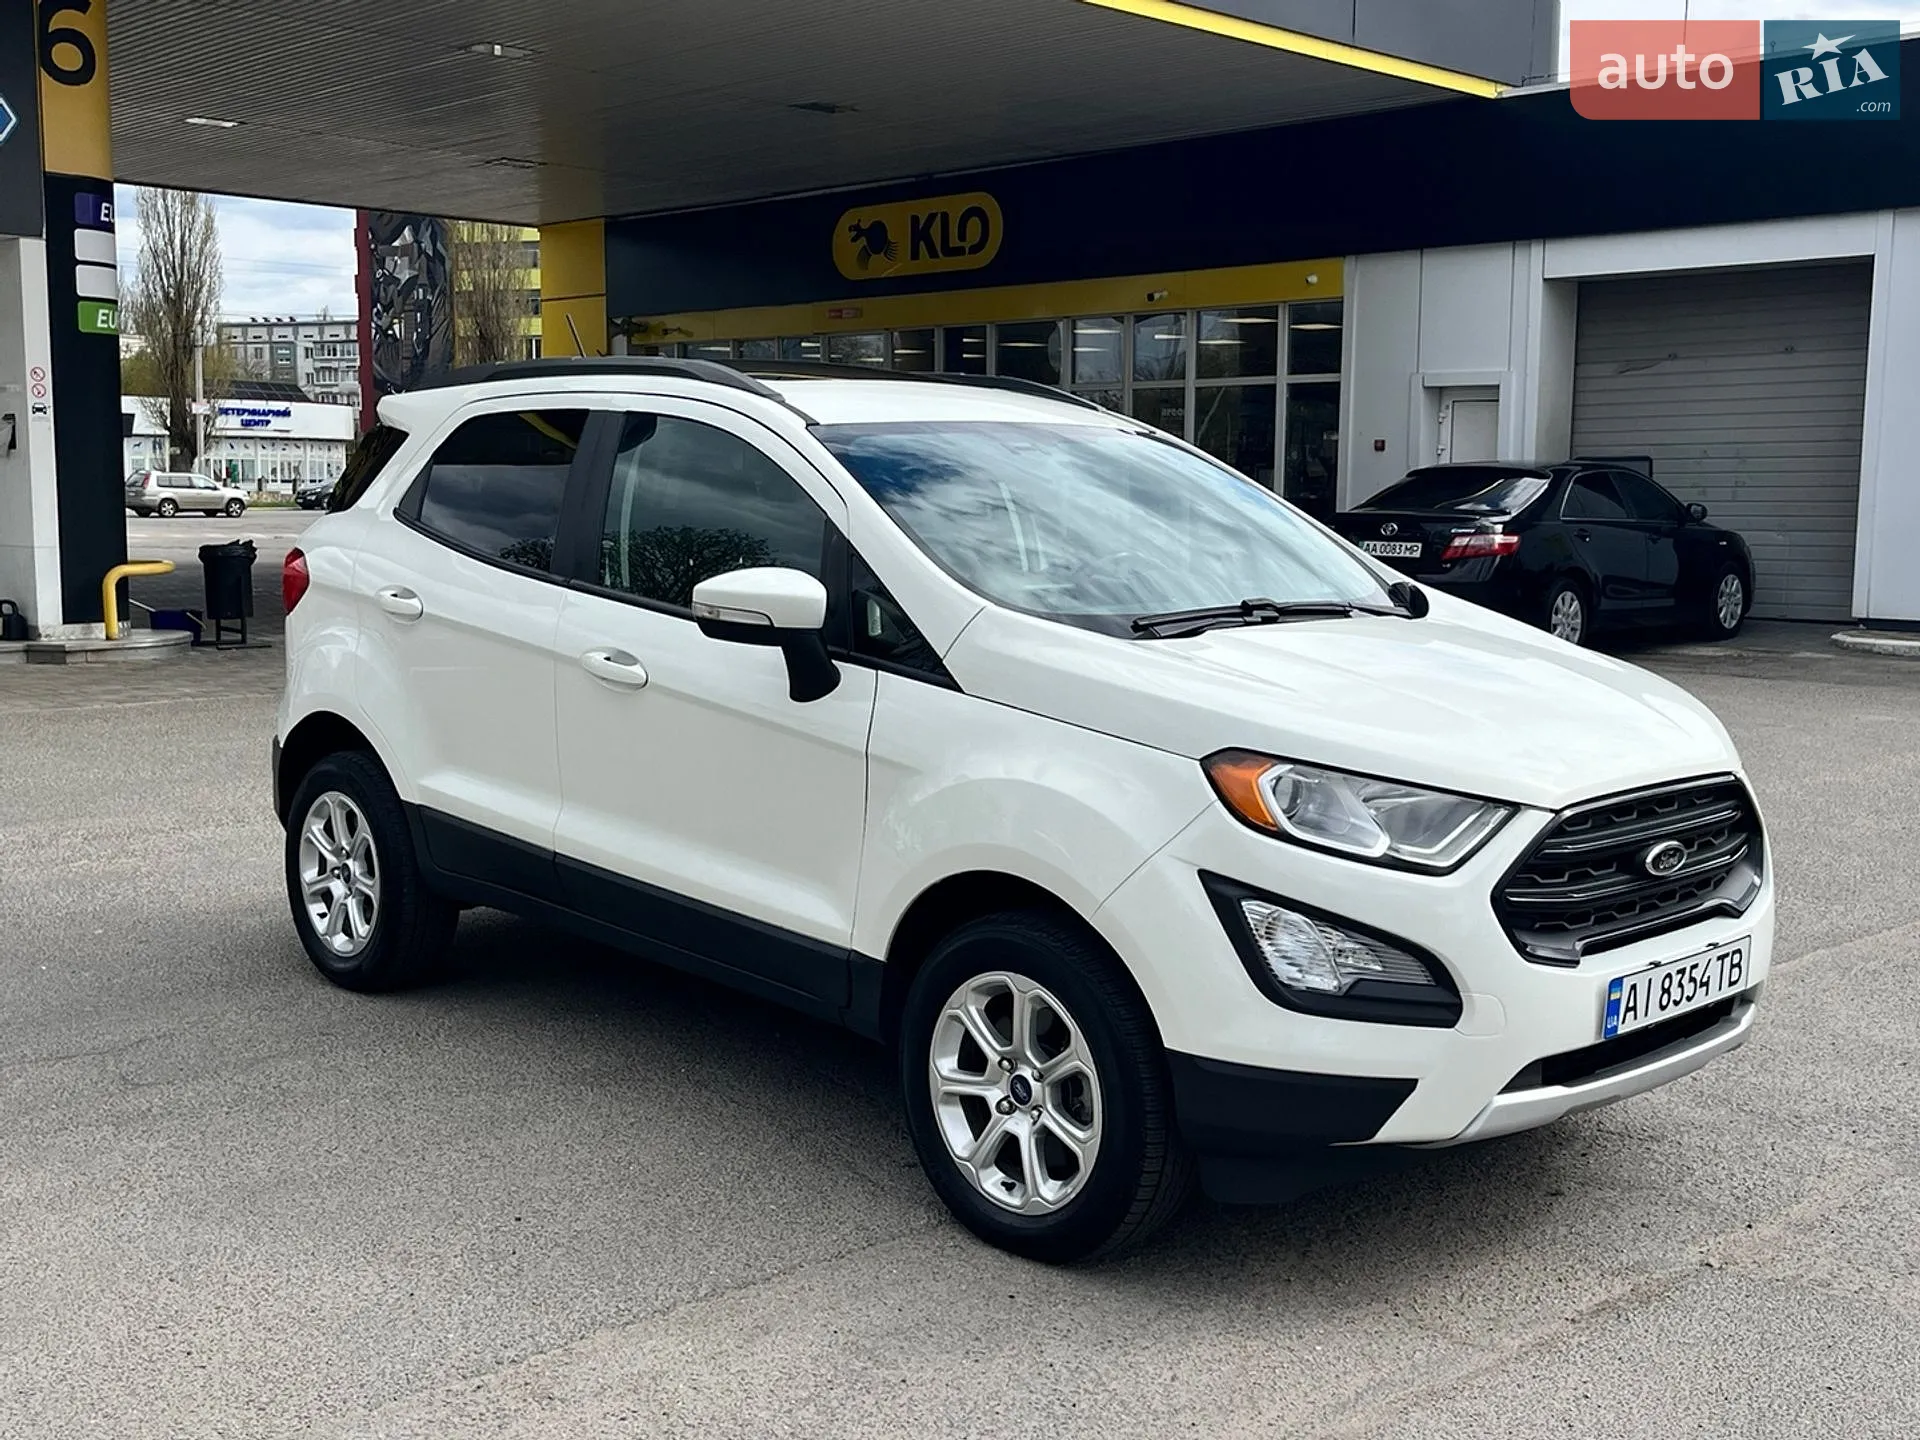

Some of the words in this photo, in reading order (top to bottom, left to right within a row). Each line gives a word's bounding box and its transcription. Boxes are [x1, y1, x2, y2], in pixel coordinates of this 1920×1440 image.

[40, 0, 96, 86] 6
[910, 206, 990, 261] KLO
[1621, 977, 1653, 1025] AI
[1659, 958, 1713, 1011] 8354
[1716, 947, 1743, 992] TB
